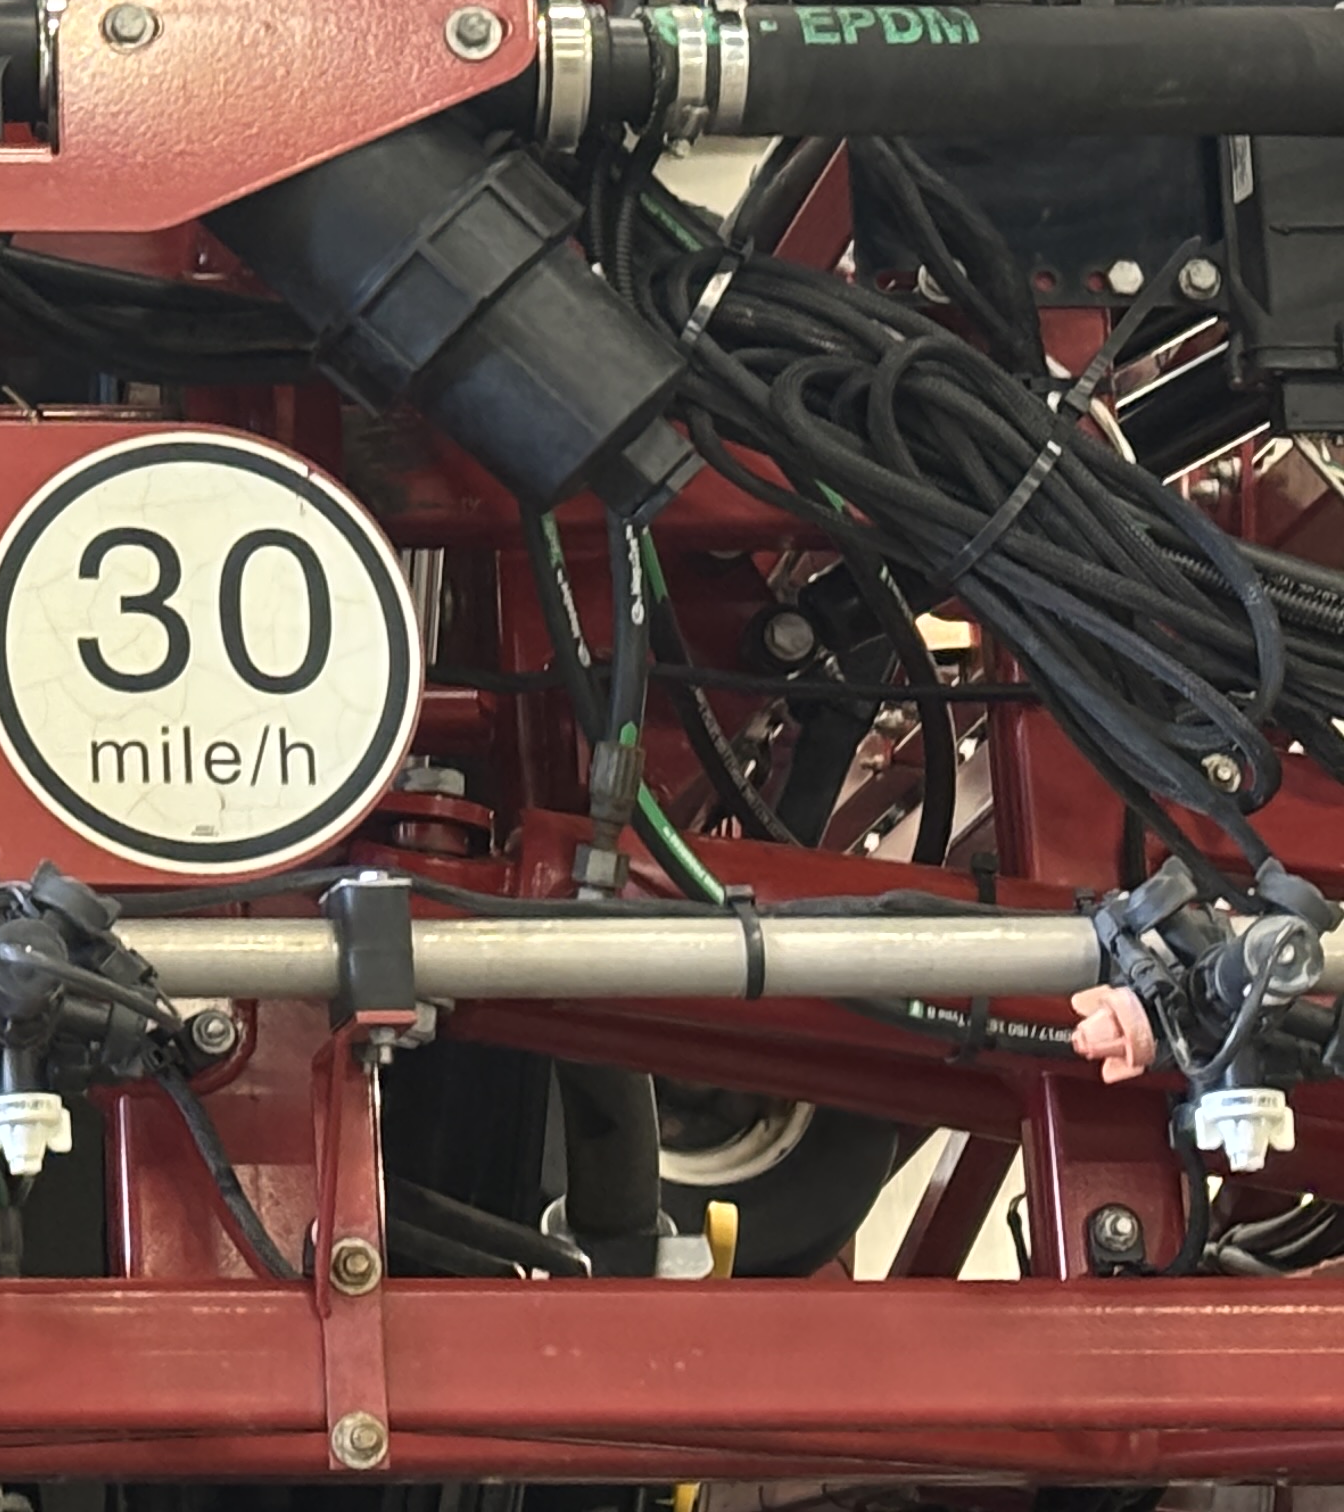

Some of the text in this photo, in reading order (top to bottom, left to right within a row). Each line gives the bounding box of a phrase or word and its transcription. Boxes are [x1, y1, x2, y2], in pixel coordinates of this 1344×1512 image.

[794, 5, 980, 45] EPDM
[76, 527, 332, 694] 30
[91, 725, 318, 787] mile/h
